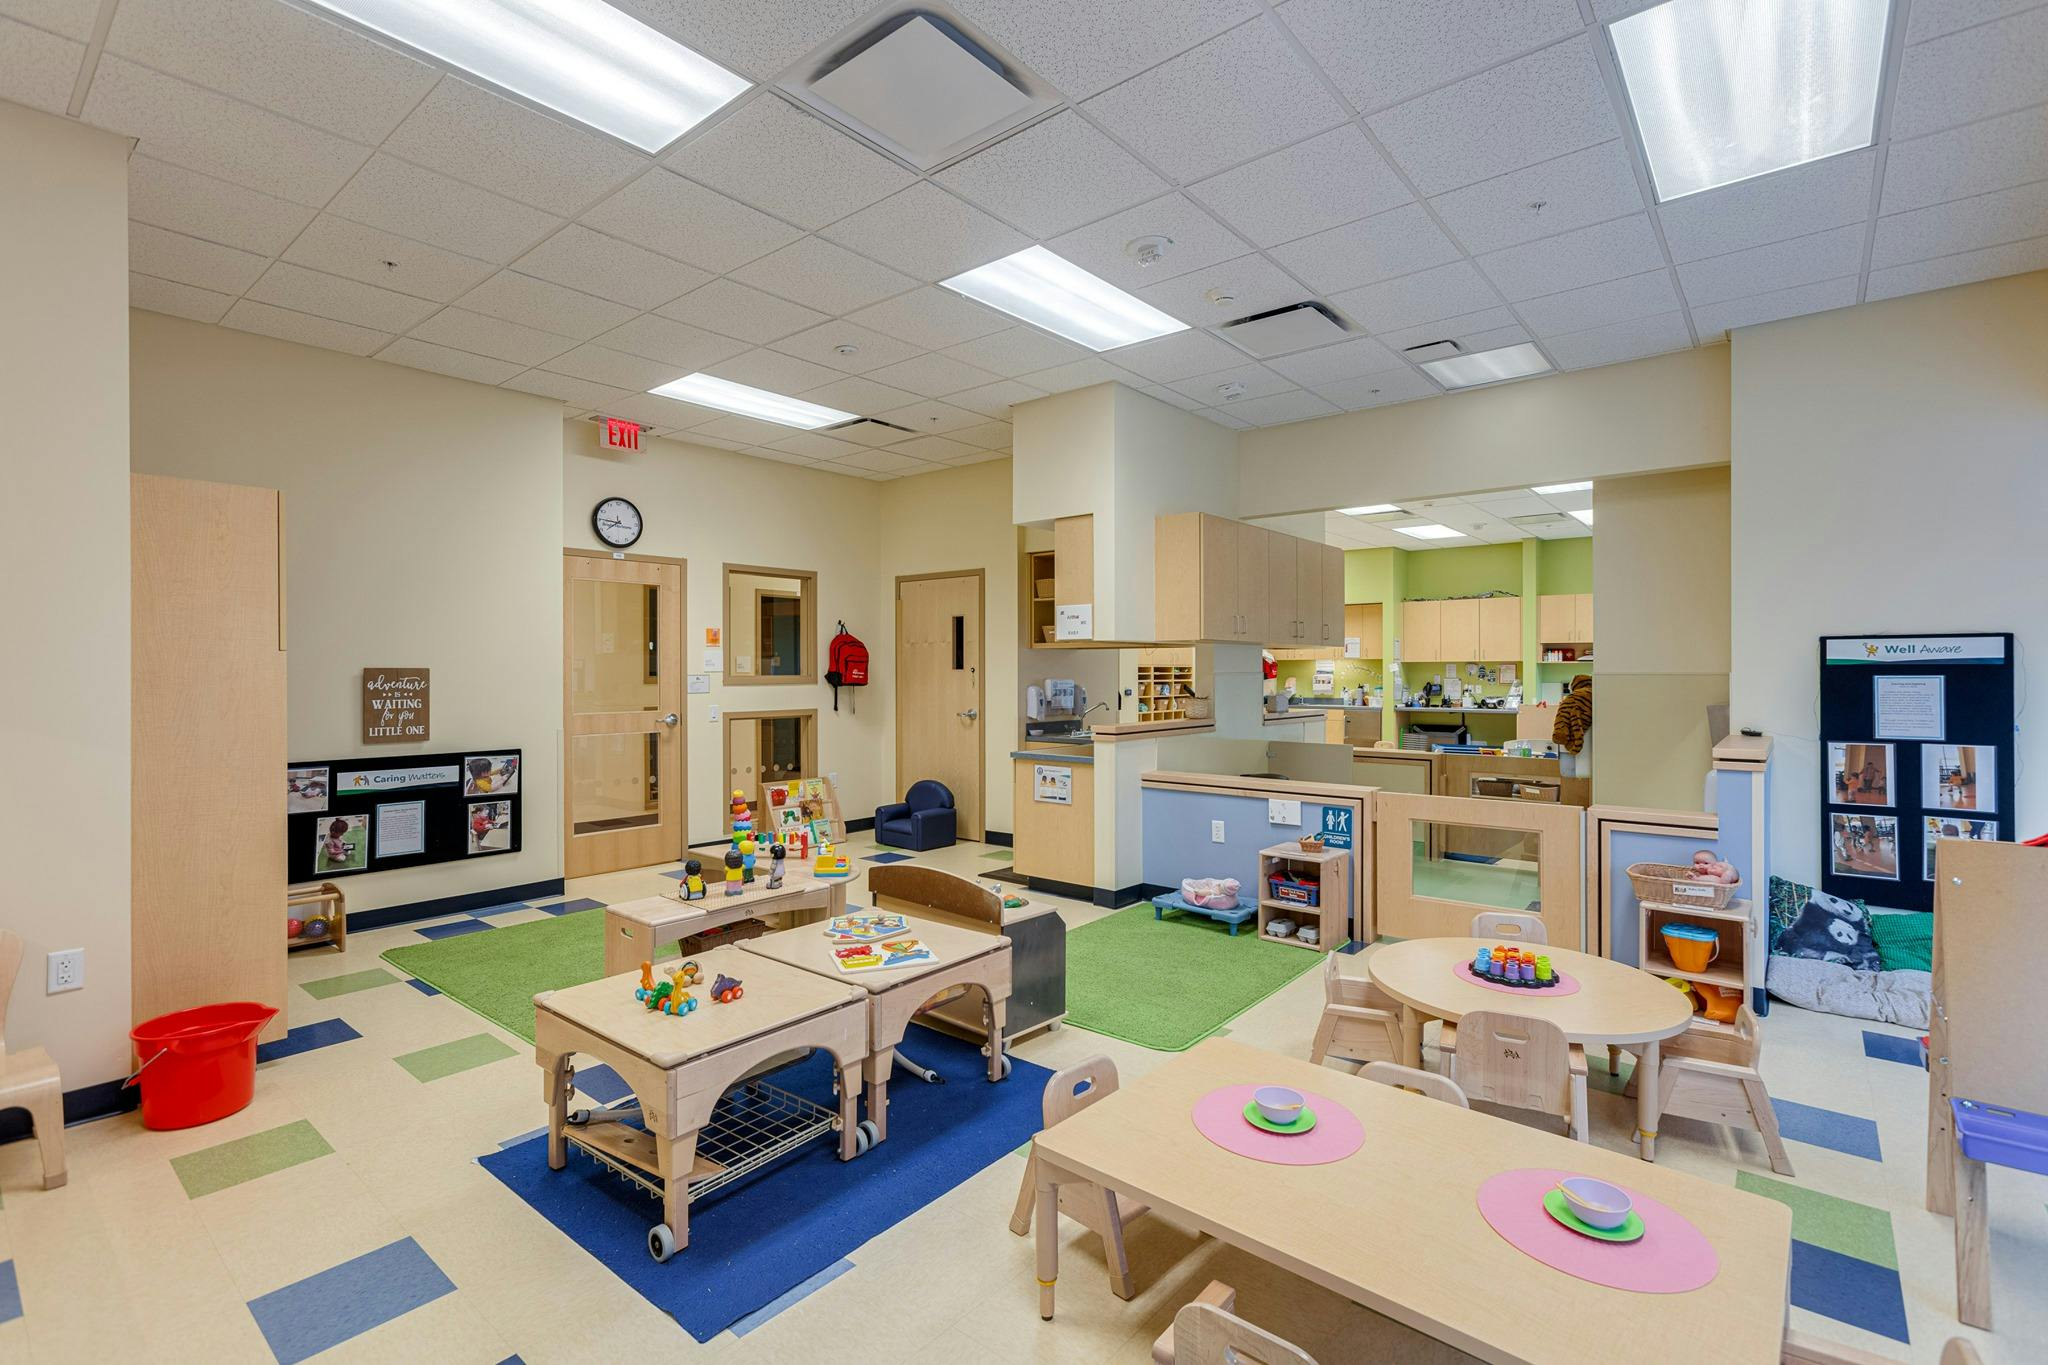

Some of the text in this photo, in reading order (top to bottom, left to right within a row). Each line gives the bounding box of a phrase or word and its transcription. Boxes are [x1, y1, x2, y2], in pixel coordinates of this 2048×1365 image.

[607, 418, 640, 450] EXIT
[1884, 644, 1962, 654] Well Aware
[367, 674, 428, 691] adventure
[372, 698, 422, 710] WAITING
[380, 707, 415, 727] for you
[368, 725, 425, 737] LITTLE ONE
[373, 774, 406, 784] Caring
